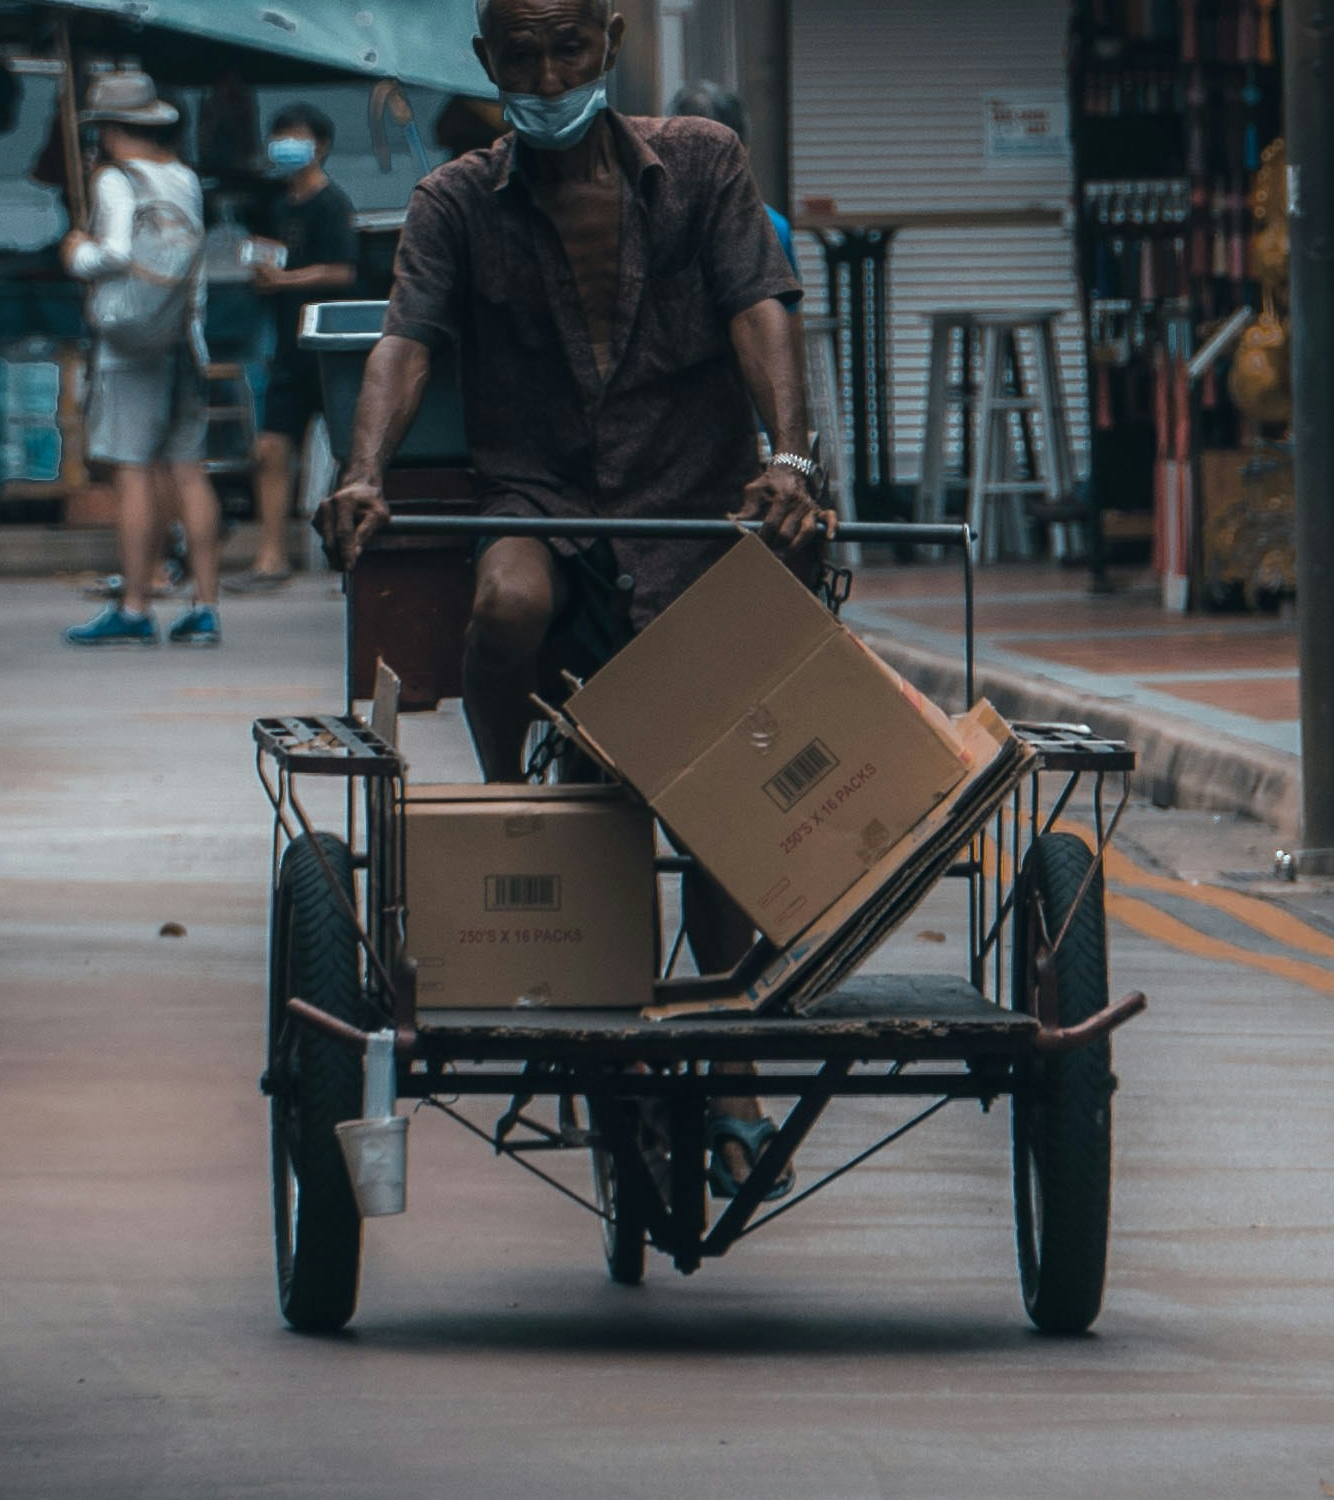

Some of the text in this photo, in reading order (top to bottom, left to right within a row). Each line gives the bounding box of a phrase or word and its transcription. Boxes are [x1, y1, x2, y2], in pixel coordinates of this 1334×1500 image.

[779, 762, 877, 854] 250'S X 16 PACKS
[459, 927, 583, 944] 250'S X 16 PACKS
